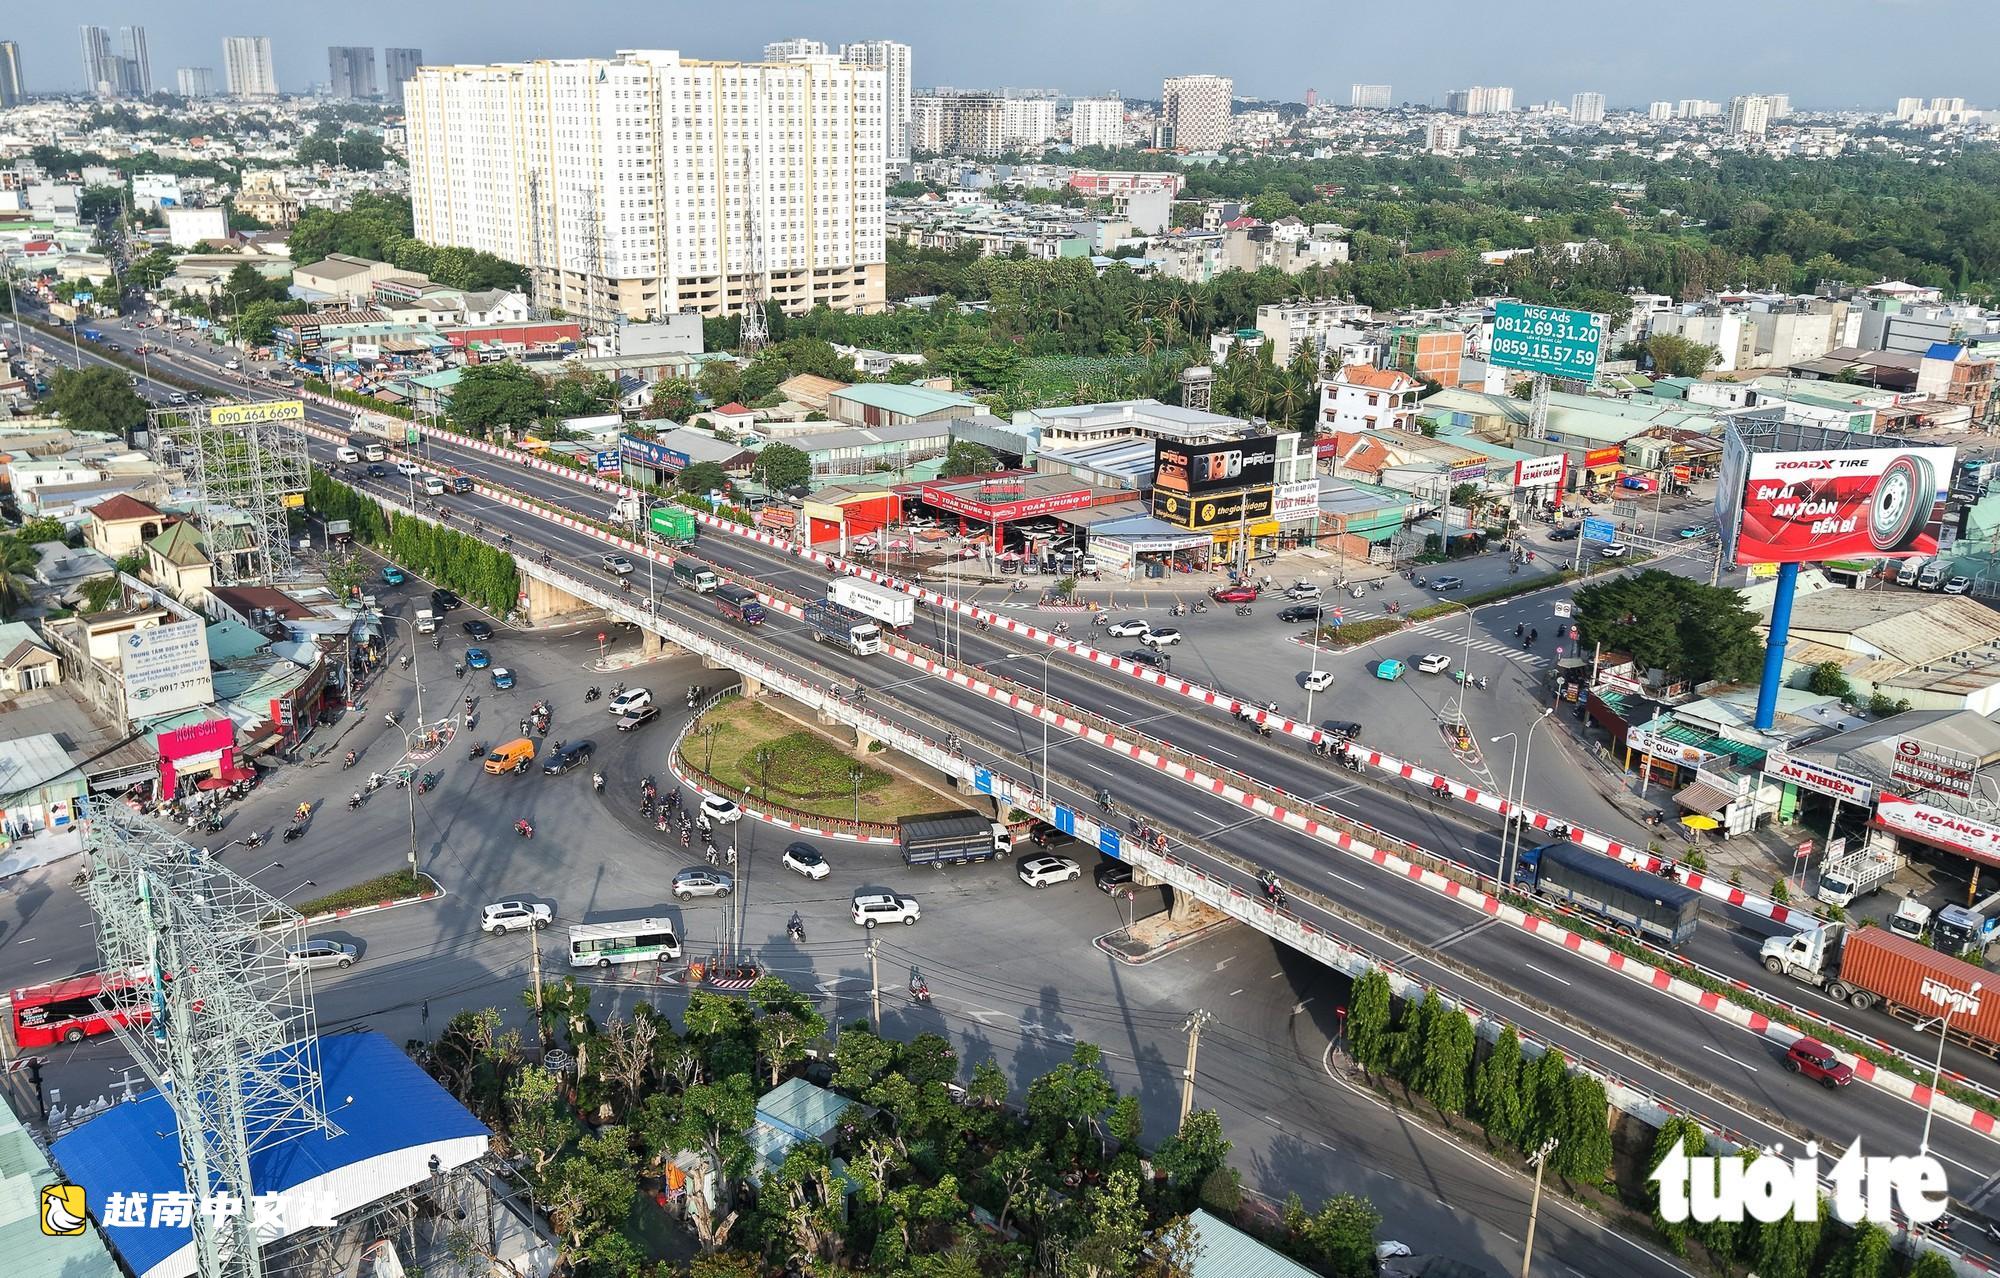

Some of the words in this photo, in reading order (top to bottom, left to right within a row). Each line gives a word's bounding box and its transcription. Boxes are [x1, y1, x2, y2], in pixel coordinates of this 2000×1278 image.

[1524, 308, 1548, 320] NSG
[1550, 312, 1571, 323] Ads
[1496, 316, 1598, 343] 0812.69.31.20
[1493, 338, 1595, 365] 0859.15.57.59
[218, 412, 241, 423] 090
[244, 410, 265, 421] 464
[269, 407, 298, 419] 6699
[1160, 451, 1188, 466] PRO
[1243, 453, 1275, 468] PRO
[1839, 459, 1870, 468] TIRE
[1522, 473, 1530, 481] XE
[1530, 471, 1542, 479] MÁY
[1543, 469, 1553, 477] GIÁ
[1757, 486, 1778, 500] ÊM
[959, 502, 983, 516] TRUNG
[1049, 496, 1079, 508] TRUNG
[1275, 496, 1294, 511] VIỆT
[1295, 493, 1316, 507] NHẬT
[1773, 503, 1793, 516] AN
[1794, 498, 1838, 516] TOÀN
[159, 682, 178, 693] 0917
[180, 679, 194, 689] 377
[196, 676, 211, 685] 776
[176, 723, 195, 742] NÓN
[1656, 743, 1678, 756] QUAY
[1923, 751, 1947, 763] HINO
[1780, 765, 1802, 778] AN
[1805, 772, 1855, 795] NHIÊN
[1893, 762, 1911, 775] TEL:
[1912, 768, 1934, 781] 0779
[1935, 774, 1951, 786] 018
[1953, 778, 1970, 791] 018
[1914, 811, 1986, 838] HOÀNG
[1903, 911, 1917, 919] JAC
[1920, 977, 1981, 1016] HMM
